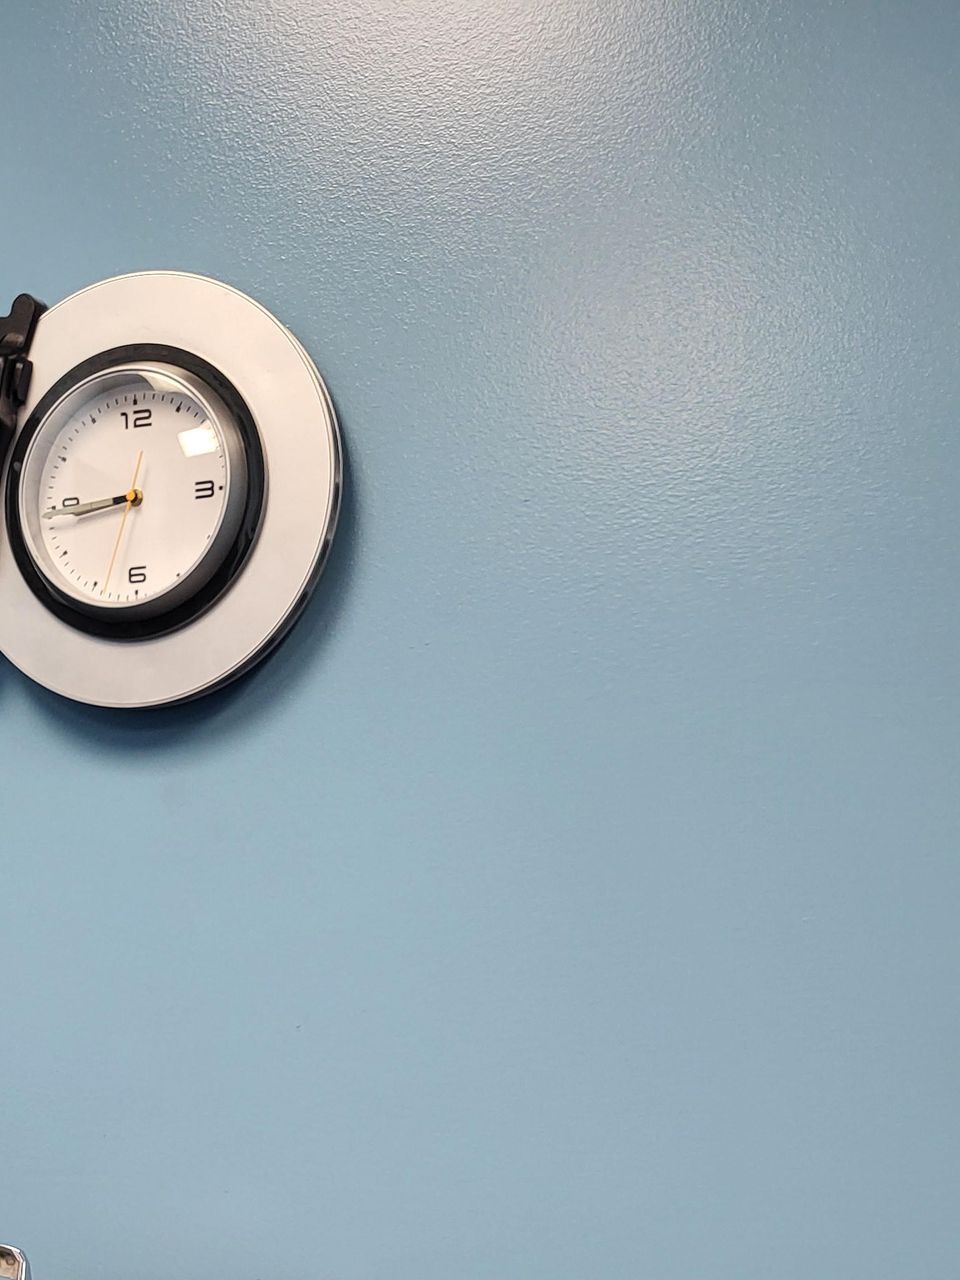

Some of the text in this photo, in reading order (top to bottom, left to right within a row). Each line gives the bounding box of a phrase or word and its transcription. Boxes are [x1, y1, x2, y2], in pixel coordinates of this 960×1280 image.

[120, 408, 153, 430] 12
[195, 480, 215, 500] 3
[128, 566, 147, 584] 6
